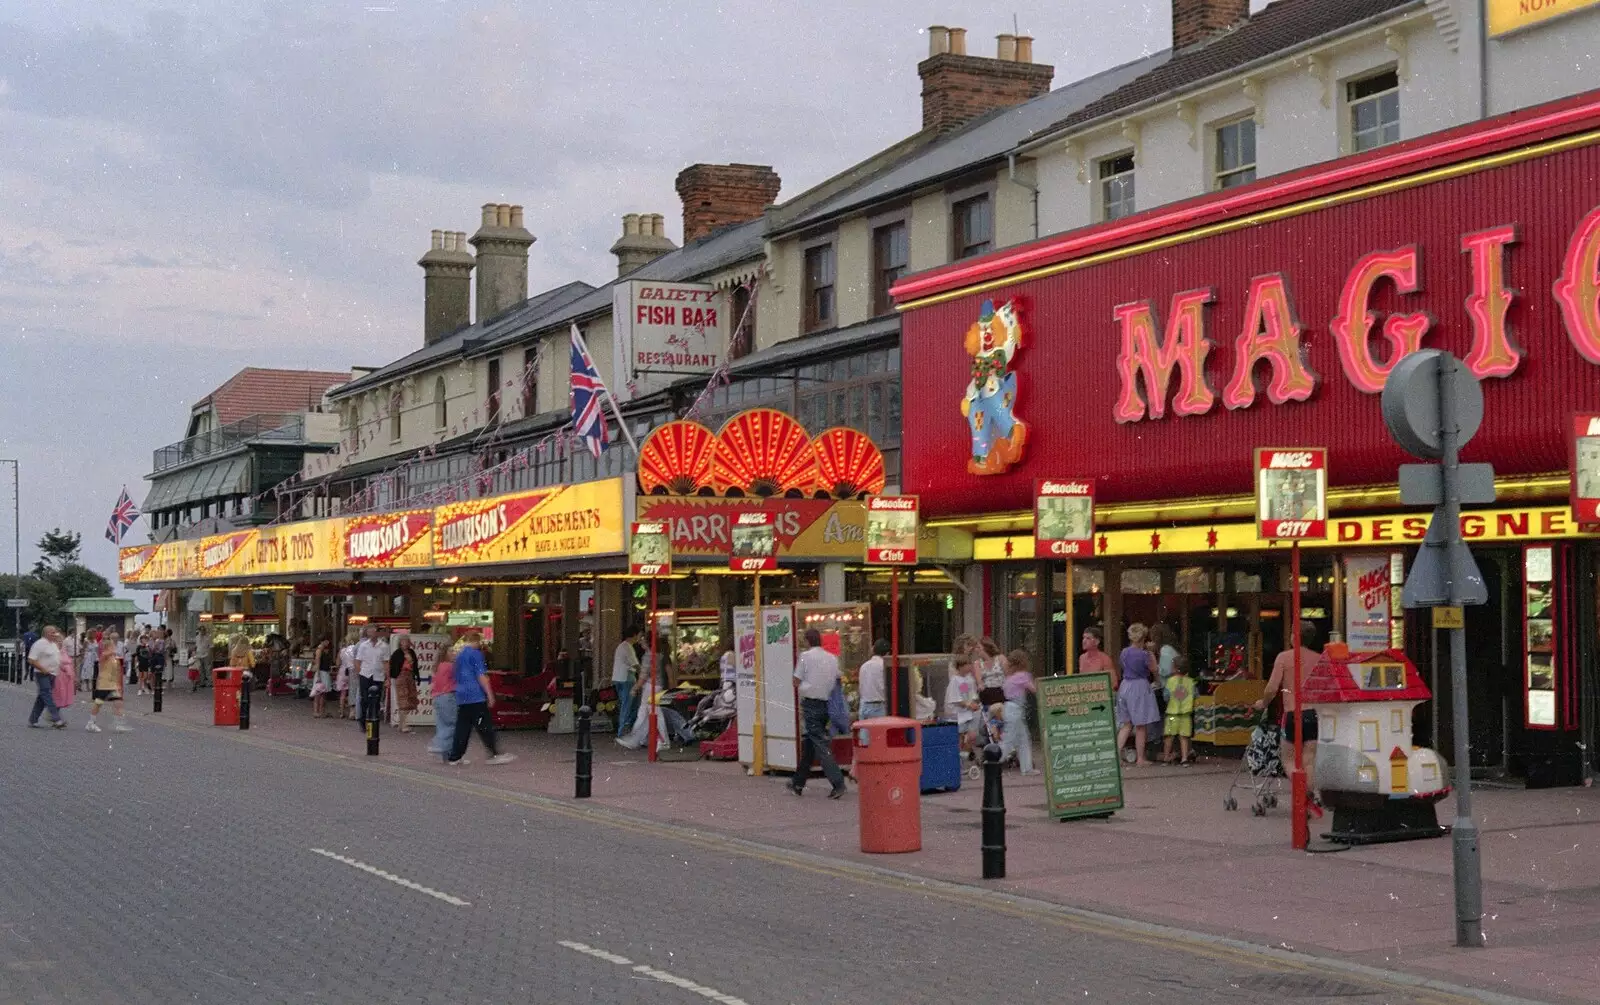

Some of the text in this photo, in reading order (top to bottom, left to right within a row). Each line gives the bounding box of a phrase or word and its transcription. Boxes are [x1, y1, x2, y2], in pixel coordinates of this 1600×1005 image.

[640, 287, 719, 303] GAIETY
[637, 305, 717, 327] FISH BAR
[638, 352, 717, 367] RESTAURANT
[1041, 480, 1089, 494] Snooker
[872, 497, 914, 509] Snooker
[442, 503, 507, 551] HARRISON'S
[530, 508, 600, 535] AMUSEMENTS
[1338, 510, 1600, 541] DESGNE
[350, 515, 409, 559] HARRISON'S
[535, 536, 590, 552] HAVE A NICE DAY
[256, 533, 313, 563] GIFTS & TOYS
[1051, 541, 1079, 553] Club
[879, 550, 904, 561] Club
[417, 652, 433, 661] AR
